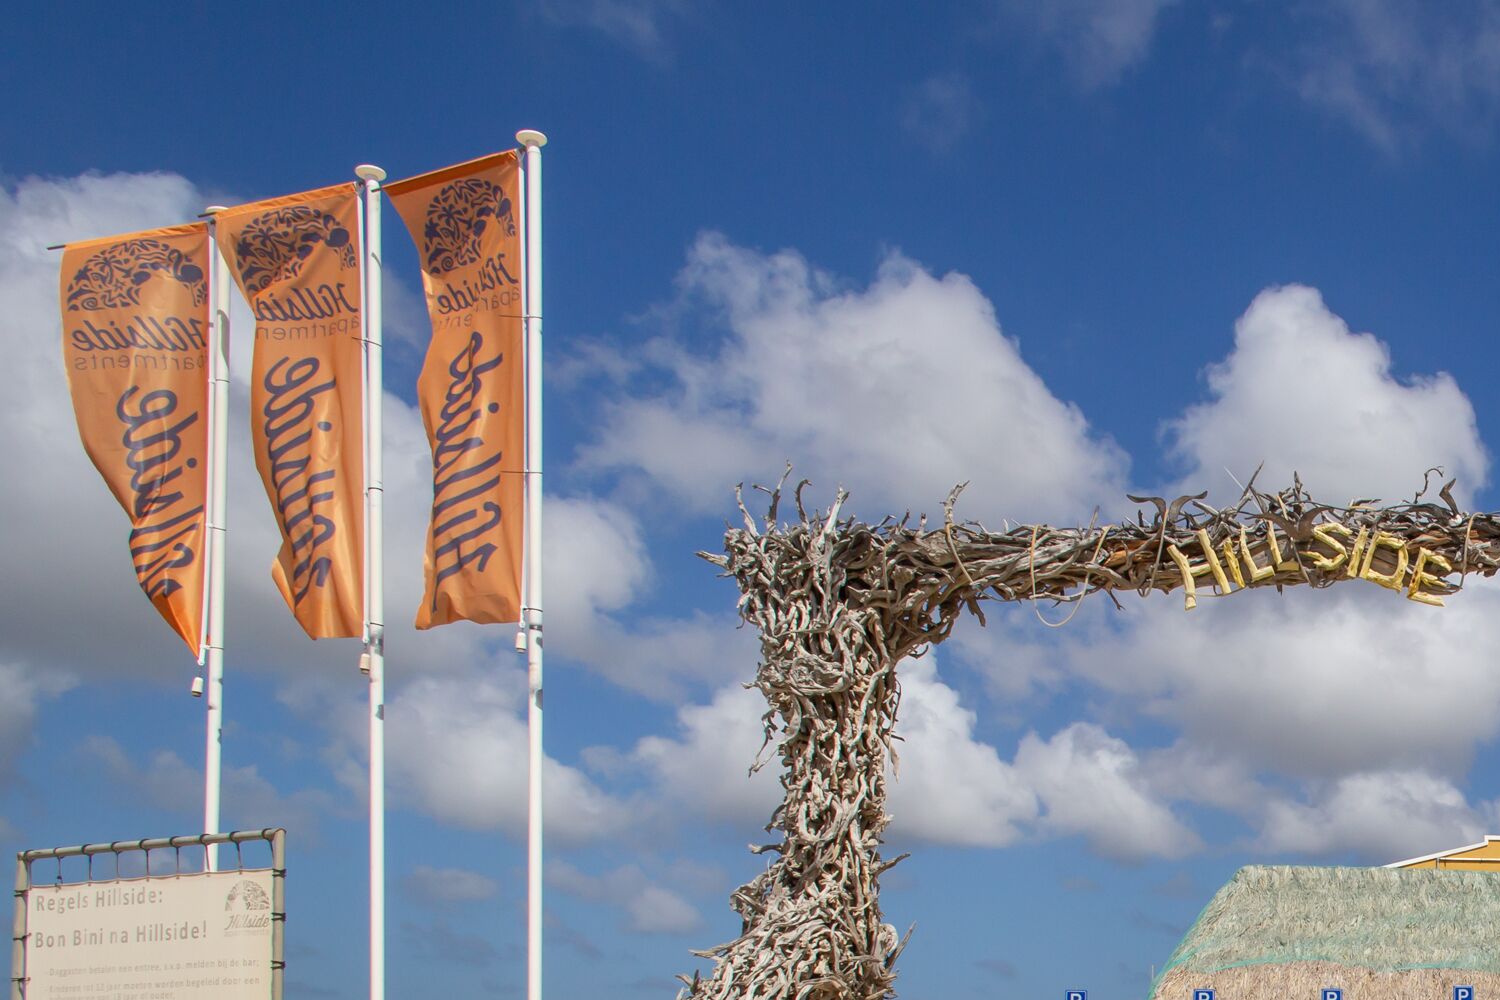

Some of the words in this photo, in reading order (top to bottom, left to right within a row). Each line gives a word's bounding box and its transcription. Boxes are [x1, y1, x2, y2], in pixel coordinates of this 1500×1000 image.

[36, 891, 89, 914] Regels
[95, 886, 163, 908] Hillside:
[35, 931, 66, 948] Bon
[73, 928, 104, 946] Bini
[110, 930, 129, 944] na
[136, 920, 208, 943] Hillside!
